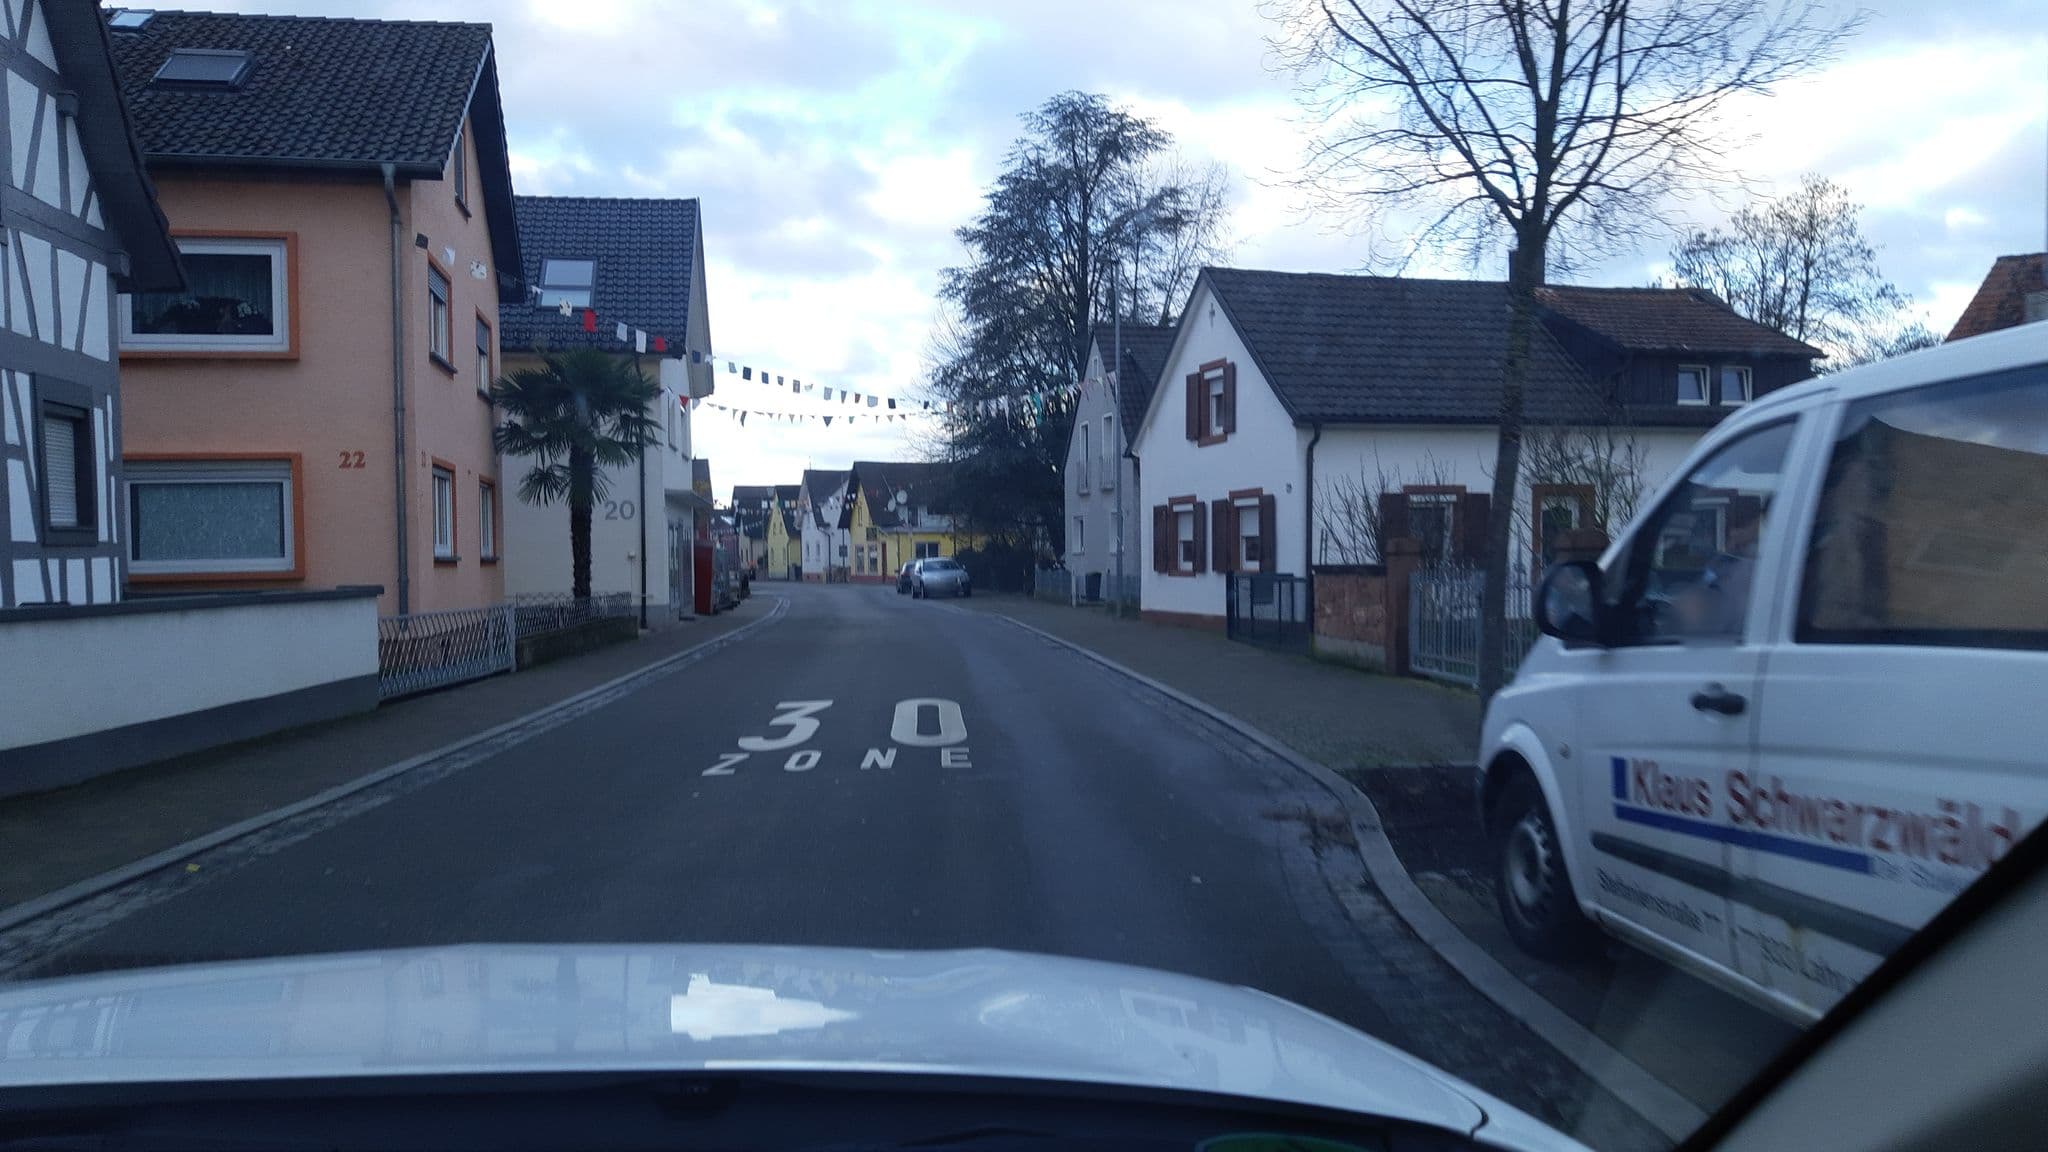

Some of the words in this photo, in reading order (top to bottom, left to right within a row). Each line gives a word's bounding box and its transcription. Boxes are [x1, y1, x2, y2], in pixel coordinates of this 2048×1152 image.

[339, 450, 366, 469] 22
[604, 500, 635, 520] 20
[738, 698, 967, 751] 30
[702, 747, 972, 776] ZONE
[1632, 757, 1713, 818] Klaus
